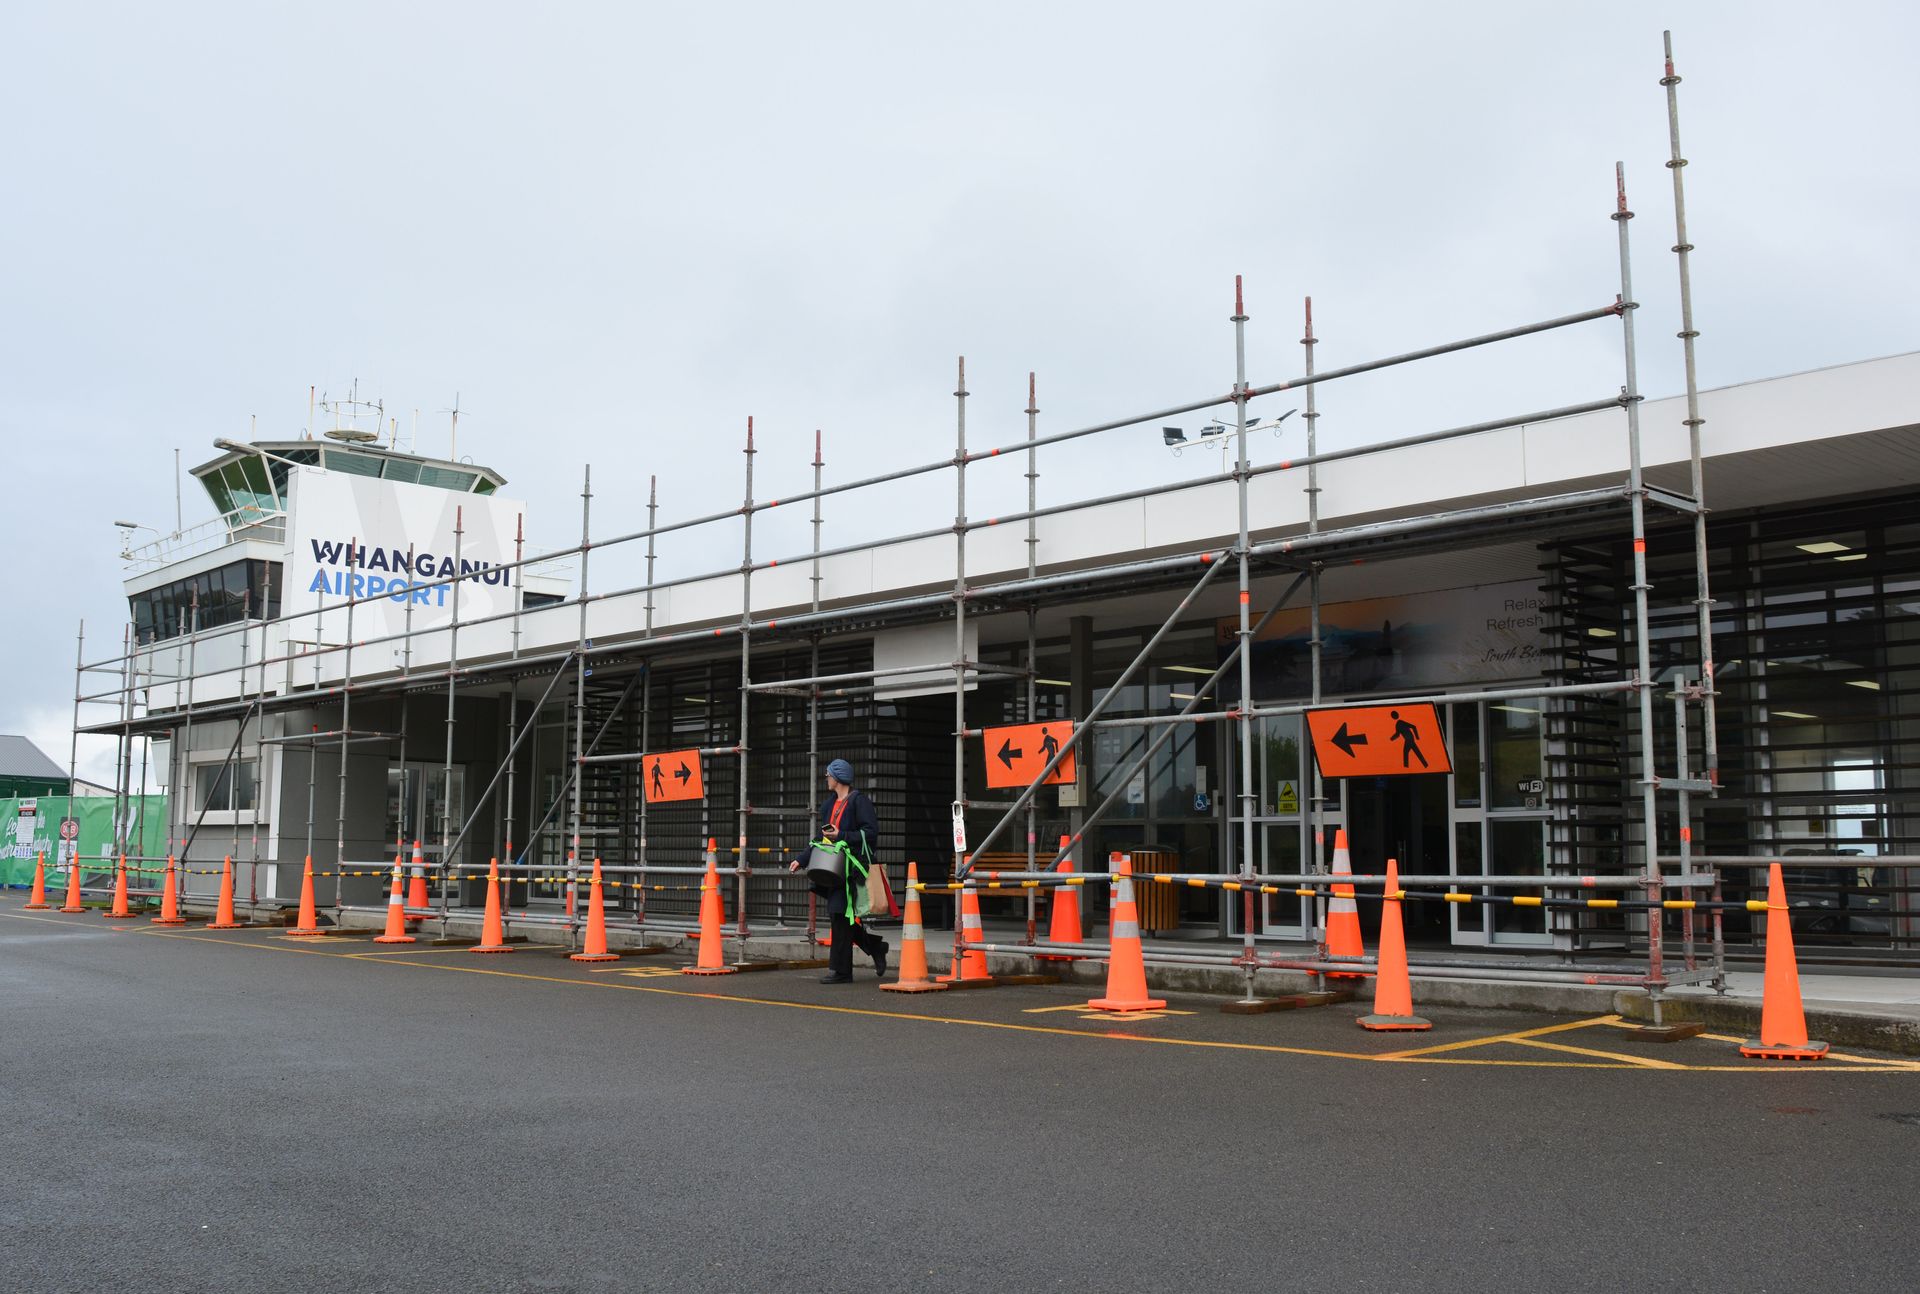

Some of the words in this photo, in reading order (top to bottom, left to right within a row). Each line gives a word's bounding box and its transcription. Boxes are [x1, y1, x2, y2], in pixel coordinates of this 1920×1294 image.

[310, 538, 511, 587] WHANGANUI
[308, 568, 451, 607] AIRPORT
[1504, 598, 1546, 611] Relax
[1487, 614, 1544, 630] Refresh
